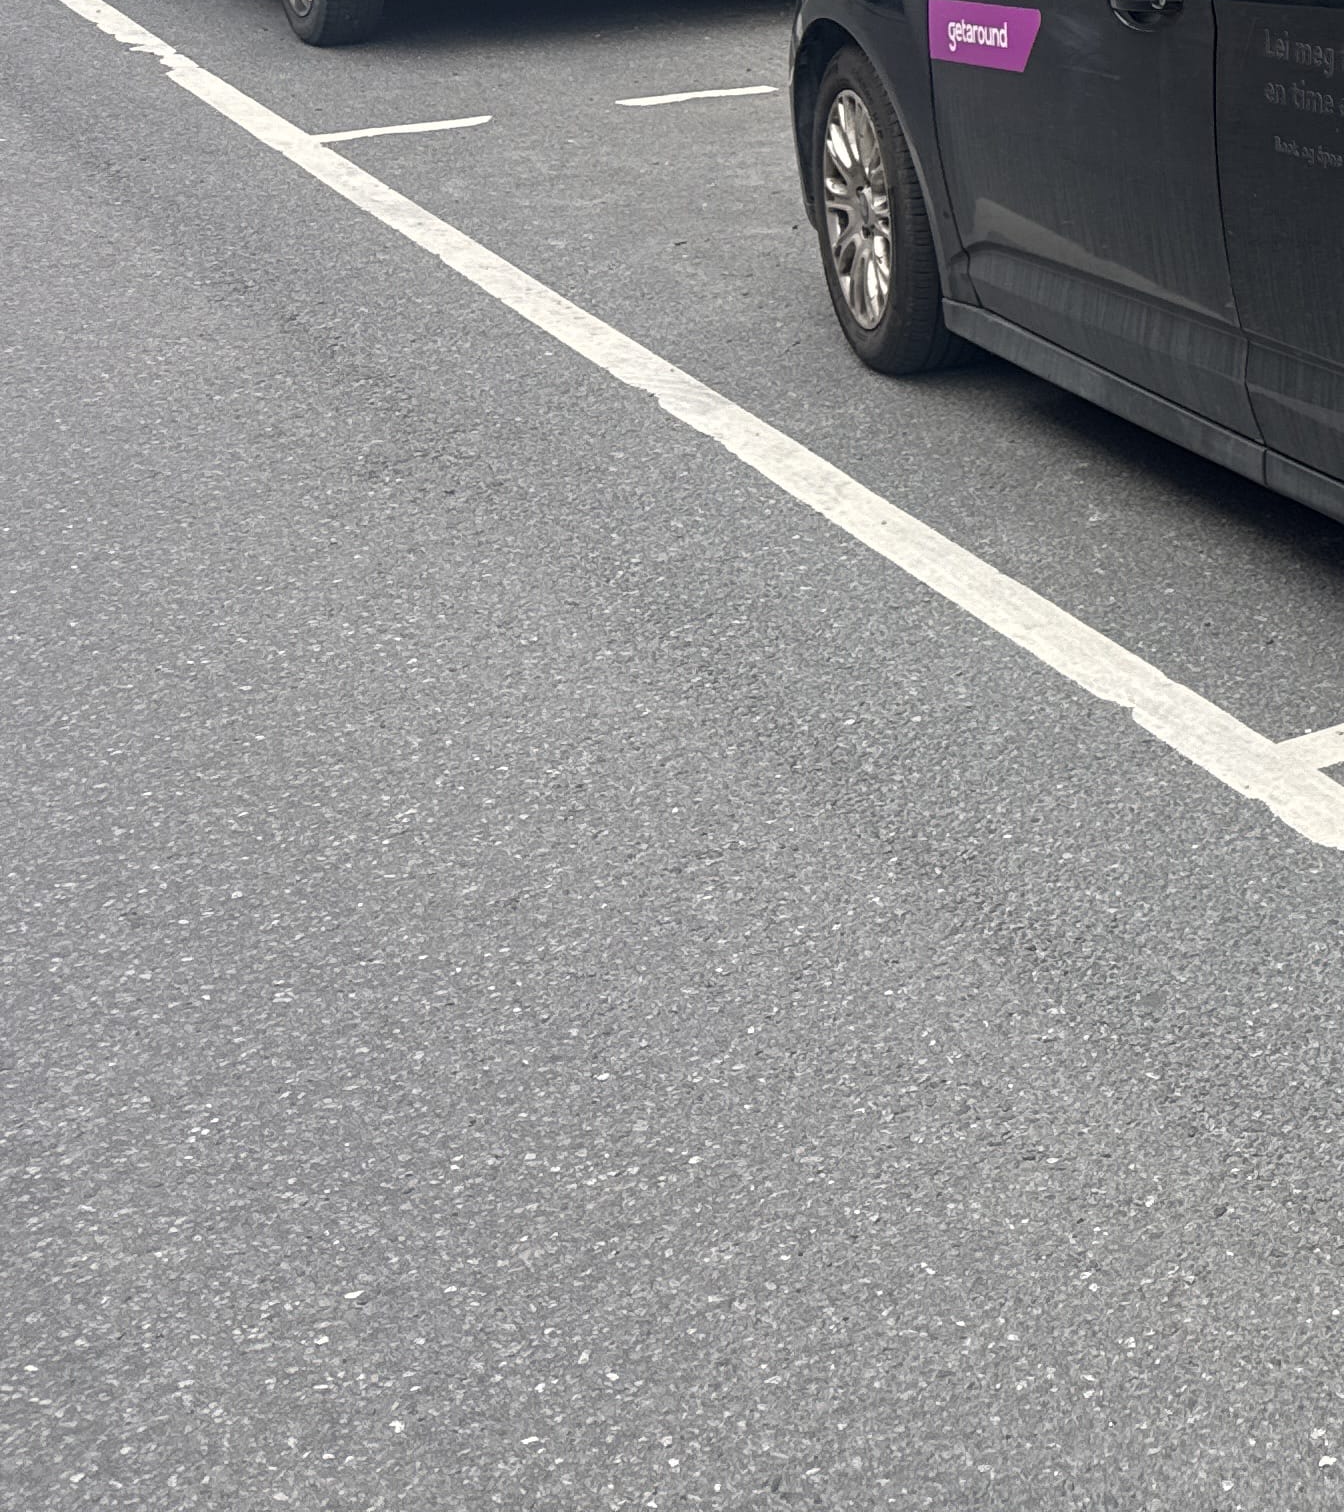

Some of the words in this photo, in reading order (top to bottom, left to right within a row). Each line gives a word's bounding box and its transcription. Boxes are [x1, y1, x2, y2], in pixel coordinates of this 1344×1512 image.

[947, 19, 1008, 52] getaround
[1264, 28, 1290, 62] Lei
[1295, 41, 1335, 79] meg
[1264, 81, 1287, 105] en
[1289, 79, 1335, 115] time
